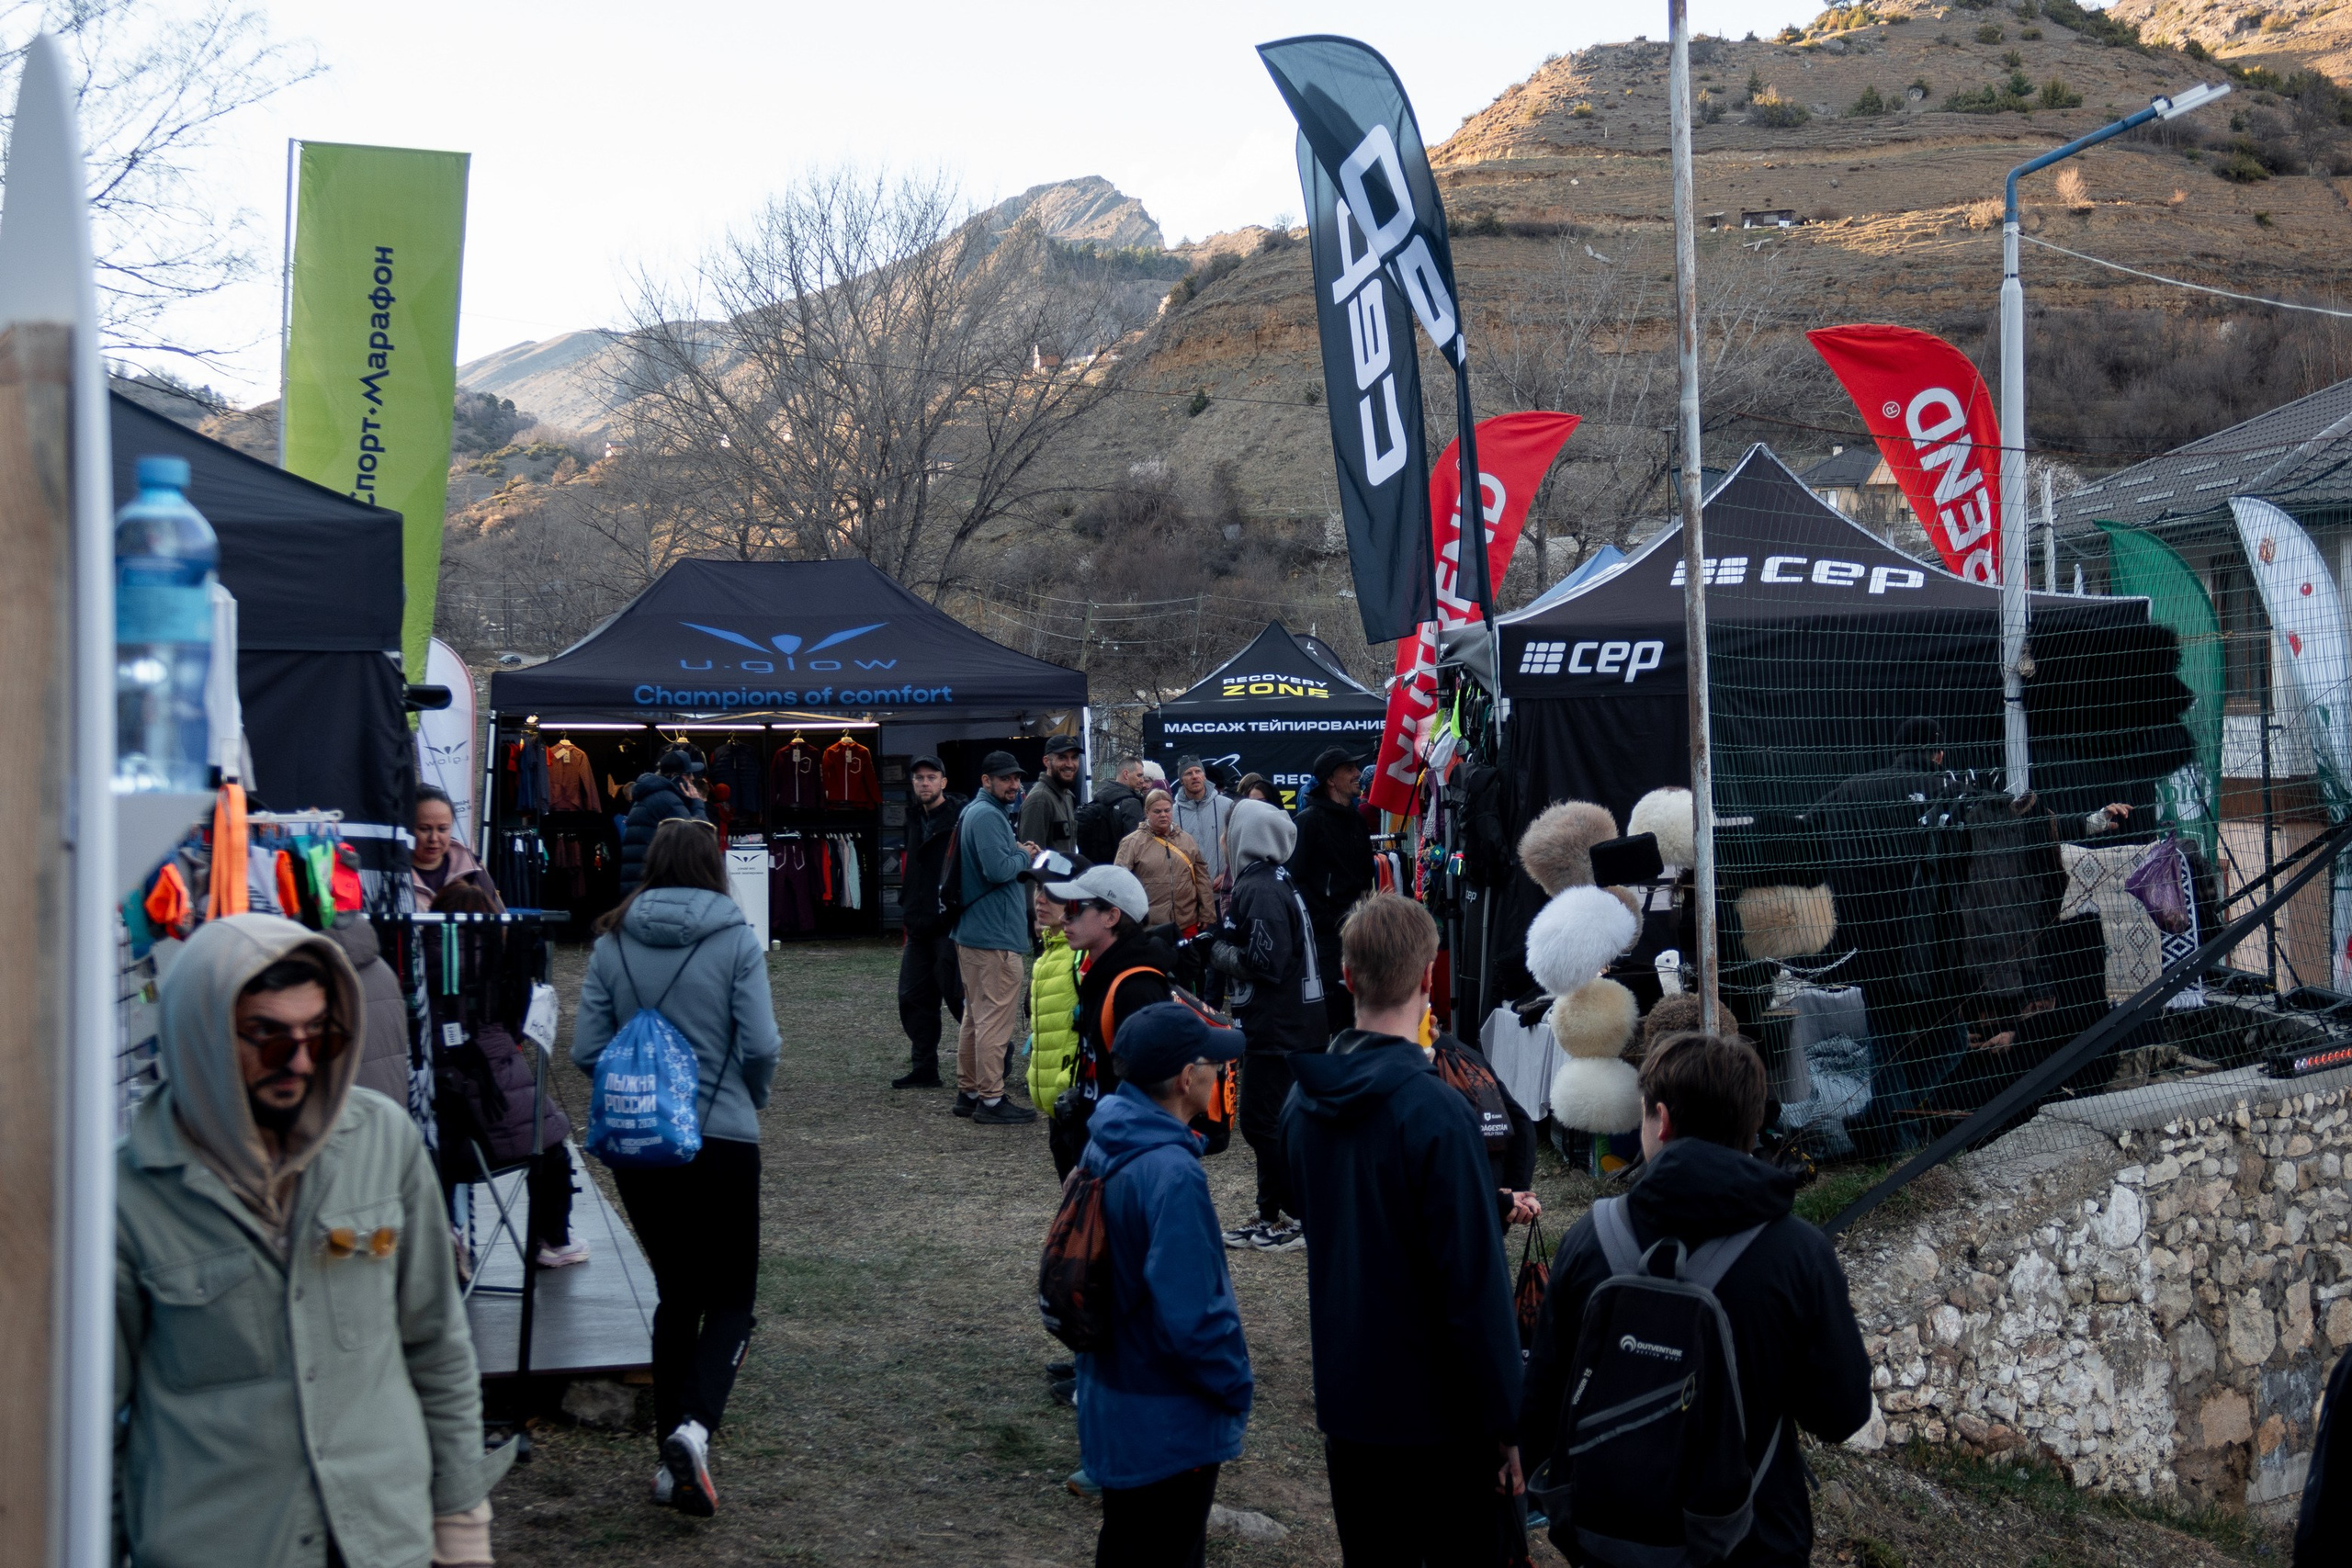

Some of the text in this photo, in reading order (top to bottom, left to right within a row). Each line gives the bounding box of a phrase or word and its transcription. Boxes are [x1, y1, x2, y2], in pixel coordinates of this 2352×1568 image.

[1223, 674, 1328, 688] RECOVERY
[634, 684, 953, 709] Champions of comfort
[1223, 682, 1329, 699] ZONE
[1164, 721, 1246, 733] МАССАЖ
[605, 1072, 656, 1092] ЛЫЖНЯ
[605, 1093, 657, 1113] РОССИИ
[1637, 1342, 1683, 1357] OUTVENTURE
